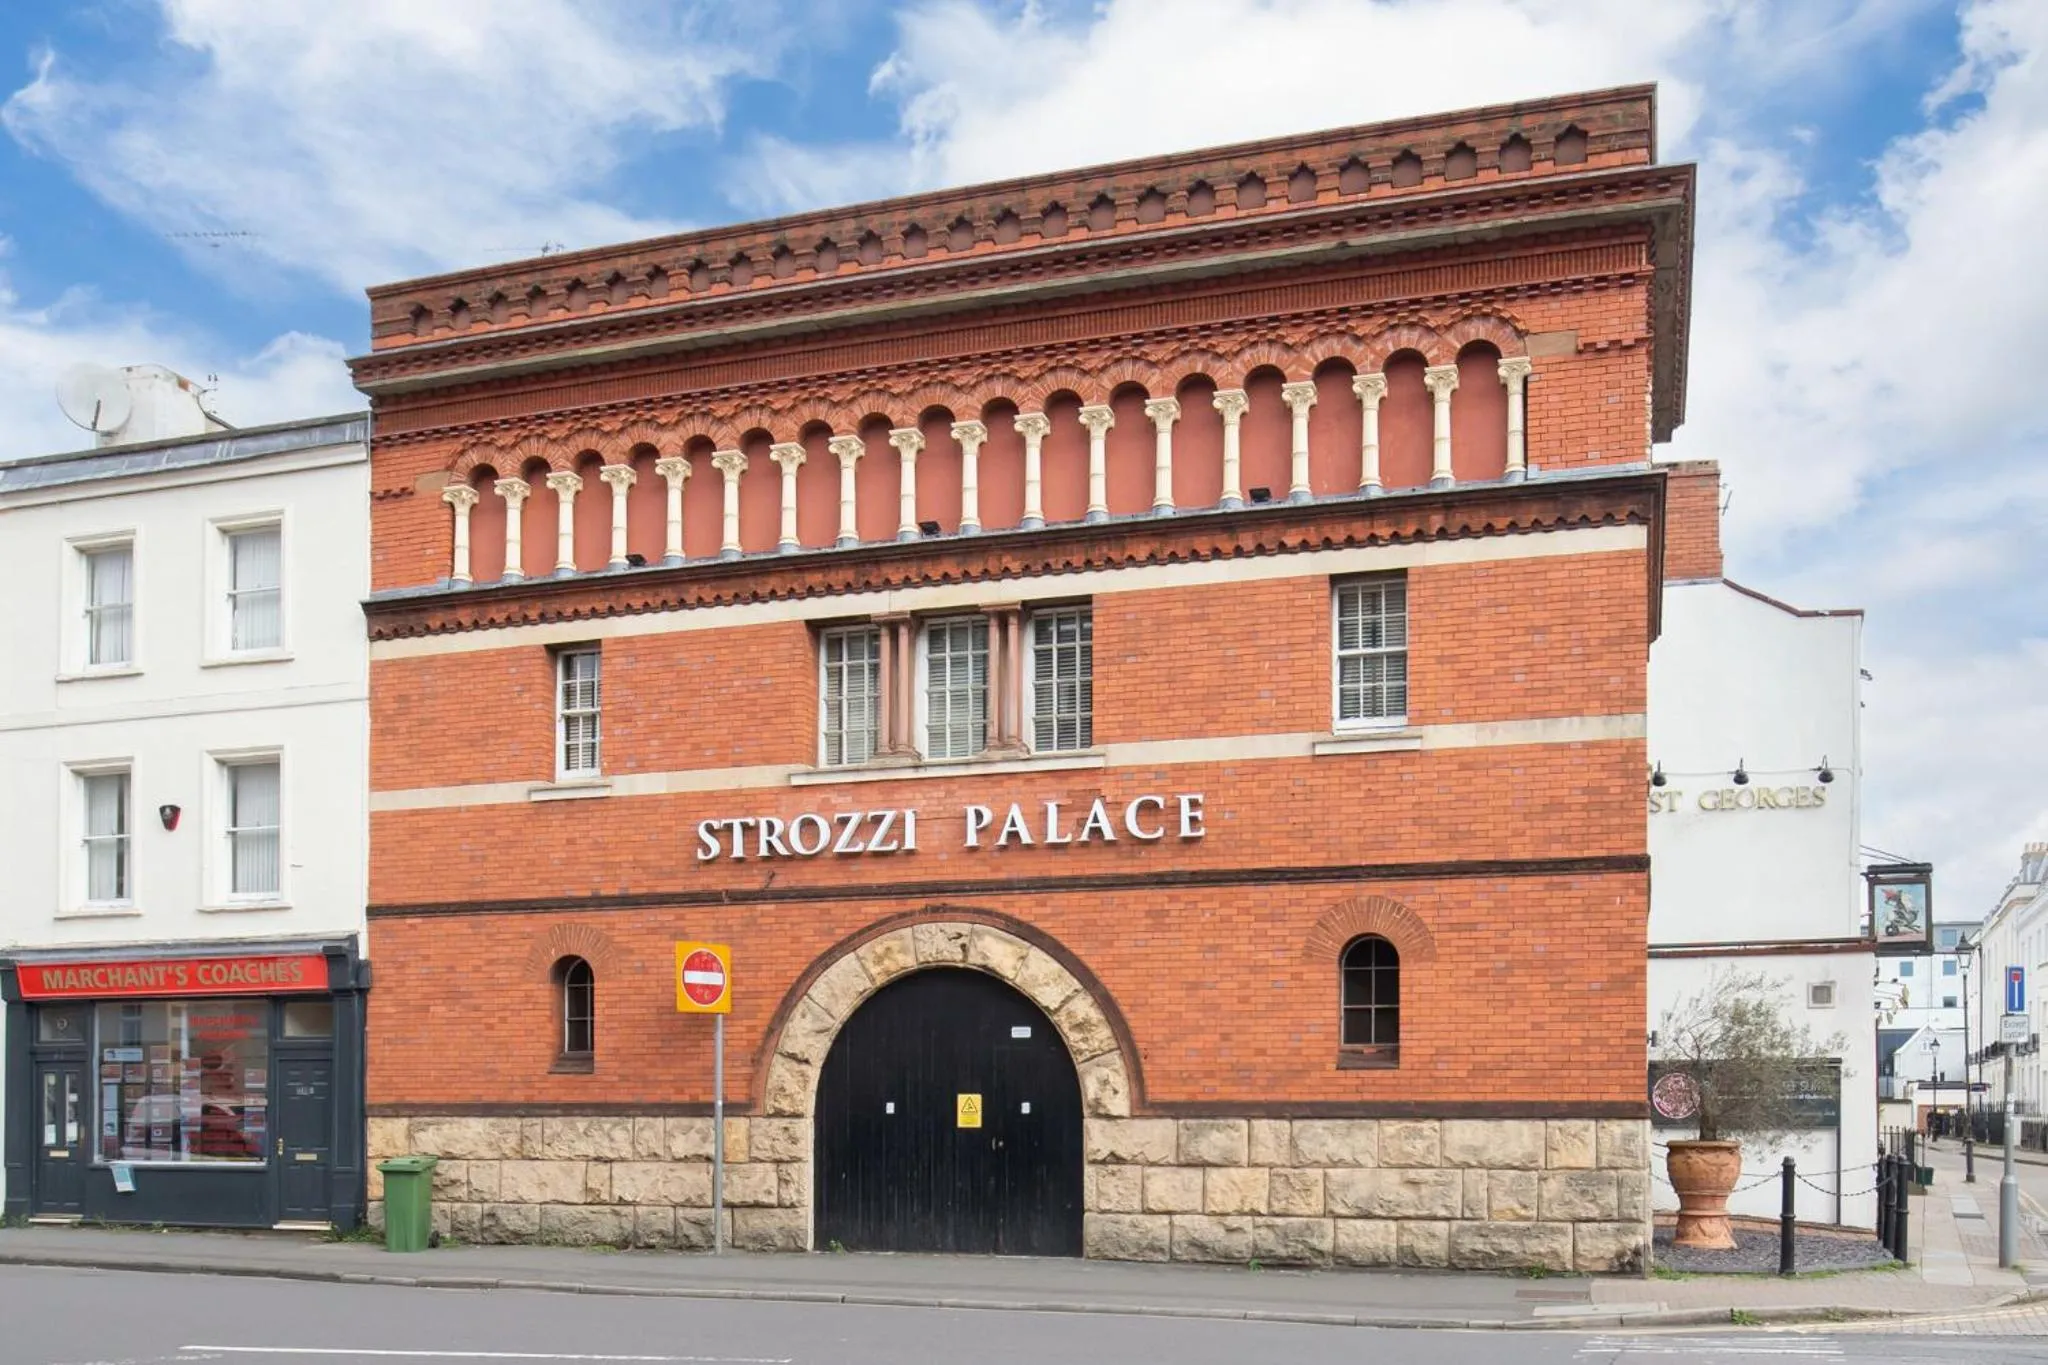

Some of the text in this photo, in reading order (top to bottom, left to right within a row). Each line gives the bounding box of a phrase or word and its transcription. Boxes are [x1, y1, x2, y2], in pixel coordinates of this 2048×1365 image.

[1649, 786, 1827, 813] ST GEORGES
[697, 793, 1206, 861] STROZZI PALACE
[42, 961, 304, 990] MARCHANT'S COACHES
